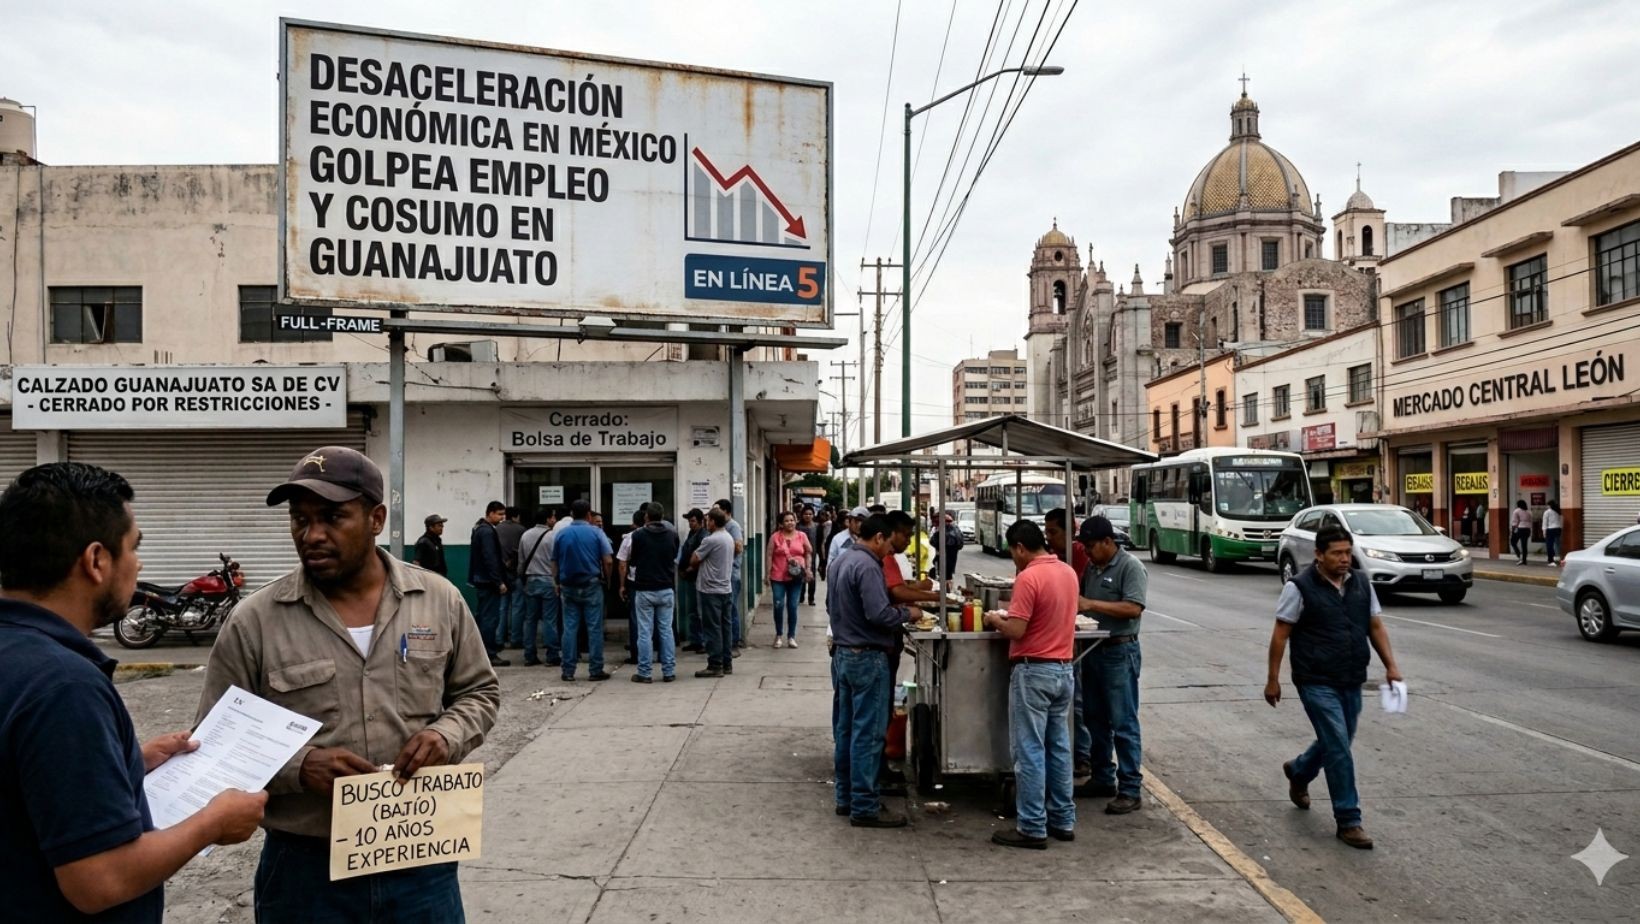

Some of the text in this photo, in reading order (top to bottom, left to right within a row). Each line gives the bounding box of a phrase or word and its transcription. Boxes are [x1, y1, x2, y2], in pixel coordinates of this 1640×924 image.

[310, 53, 623, 119] DESACELERACIÓN
[310, 100, 678, 165] ECONÓMICA EN MÉXICO
[309, 145, 610, 203] GOLPEA EMPLEO
[308, 191, 554, 242] Y COSUMO EN
[309, 237, 558, 286] GUANAJUATO
[694, 266, 819, 299] EN LÍNEA 5
[280, 315, 381, 332] FULL-FRAME
[17, 376, 341, 394] CALZADO GUANAJUATO SA DE CV
[1393, 350, 1625, 417] MERCADO CENTRAL LEÓN
[39, 397, 126, 413] CERRADO
[132, 397, 169, 412] POR
[174, 396, 320, 412] RESTRICCIONES
[549, 411, 629, 427] Cerrado:
[511, 431, 667, 449] Bolsa de Trabajo
[341, 772, 483, 806] BUSCO TRABAJO
[355, 826, 377, 848] 10
[384, 819, 434, 842] AÑOS
[347, 837, 471, 871] EXPERIENCIA
